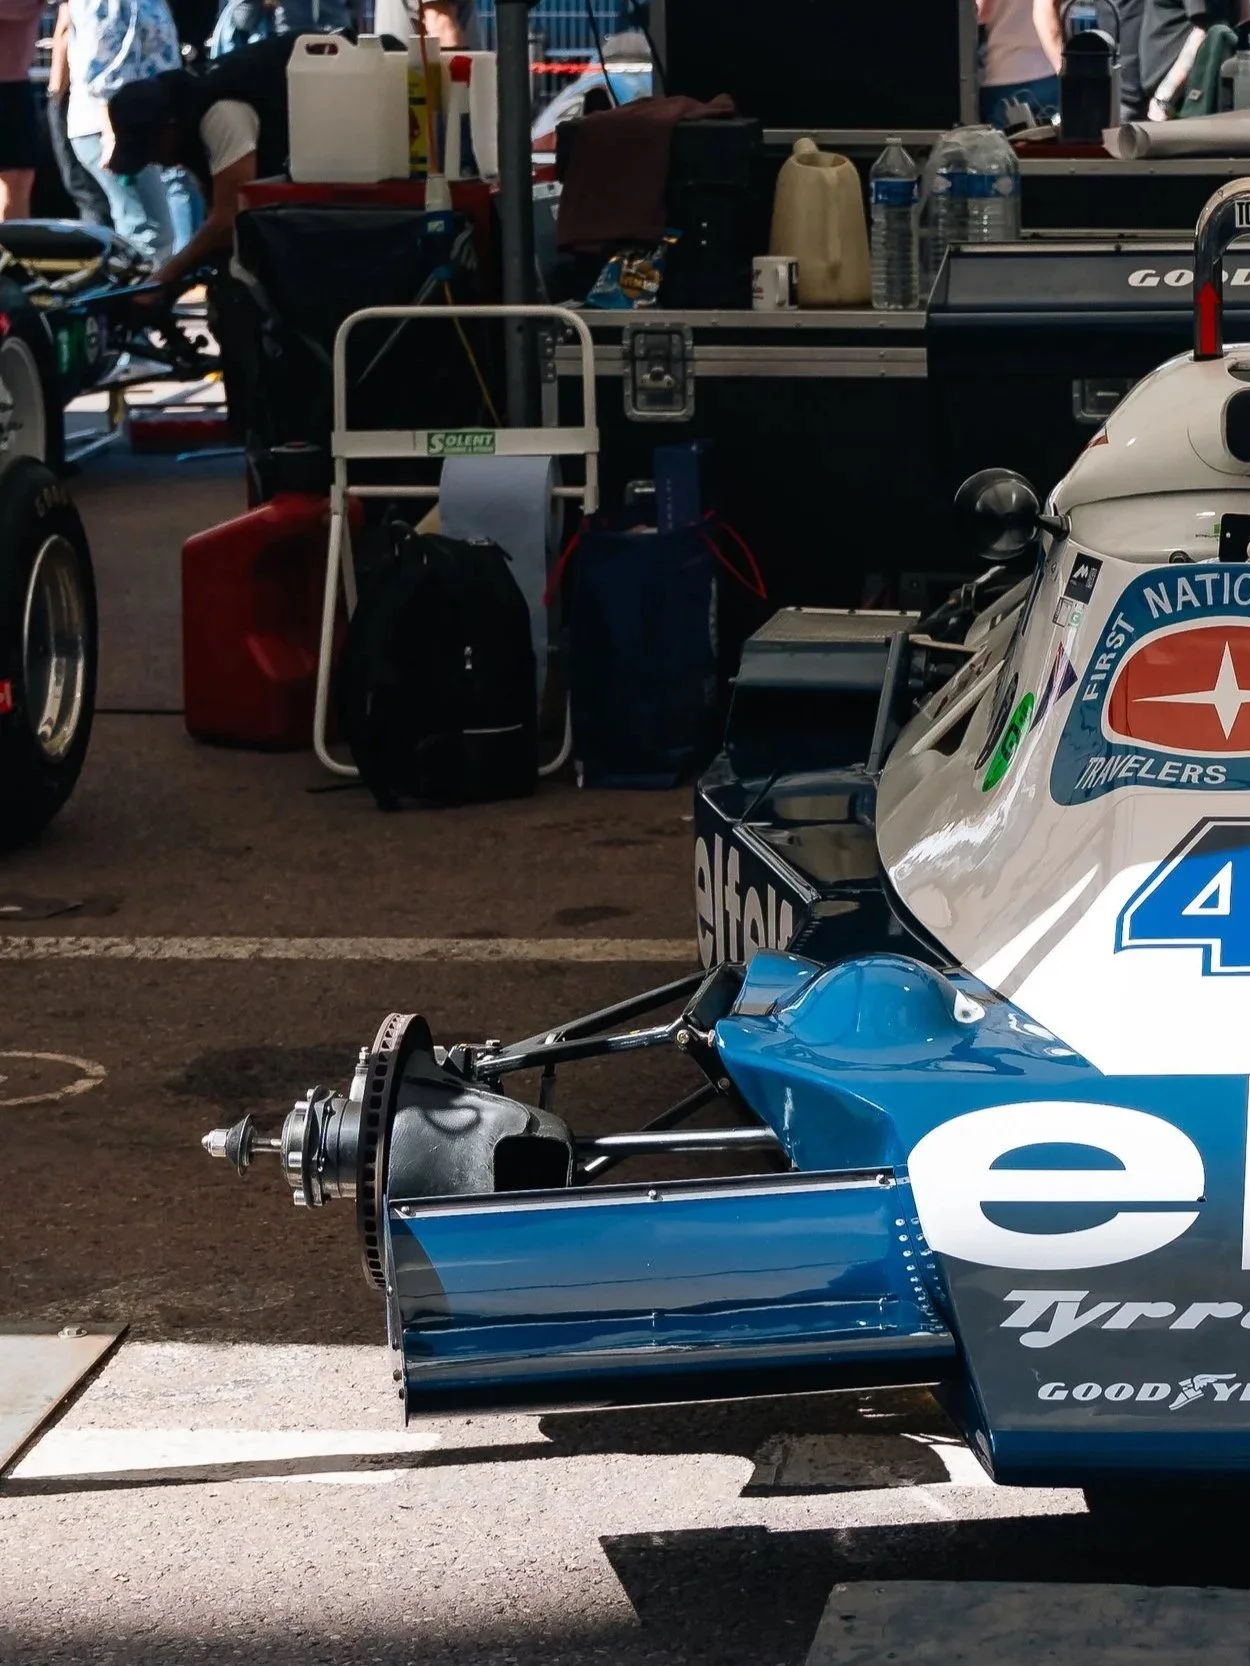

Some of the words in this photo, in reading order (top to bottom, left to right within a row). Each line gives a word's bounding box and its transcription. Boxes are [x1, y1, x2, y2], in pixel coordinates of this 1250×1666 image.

[429, 433, 493, 454] SOLENT
[1082, 612, 1135, 701] FIRST
[1073, 754, 1228, 791] TRAVELERS
